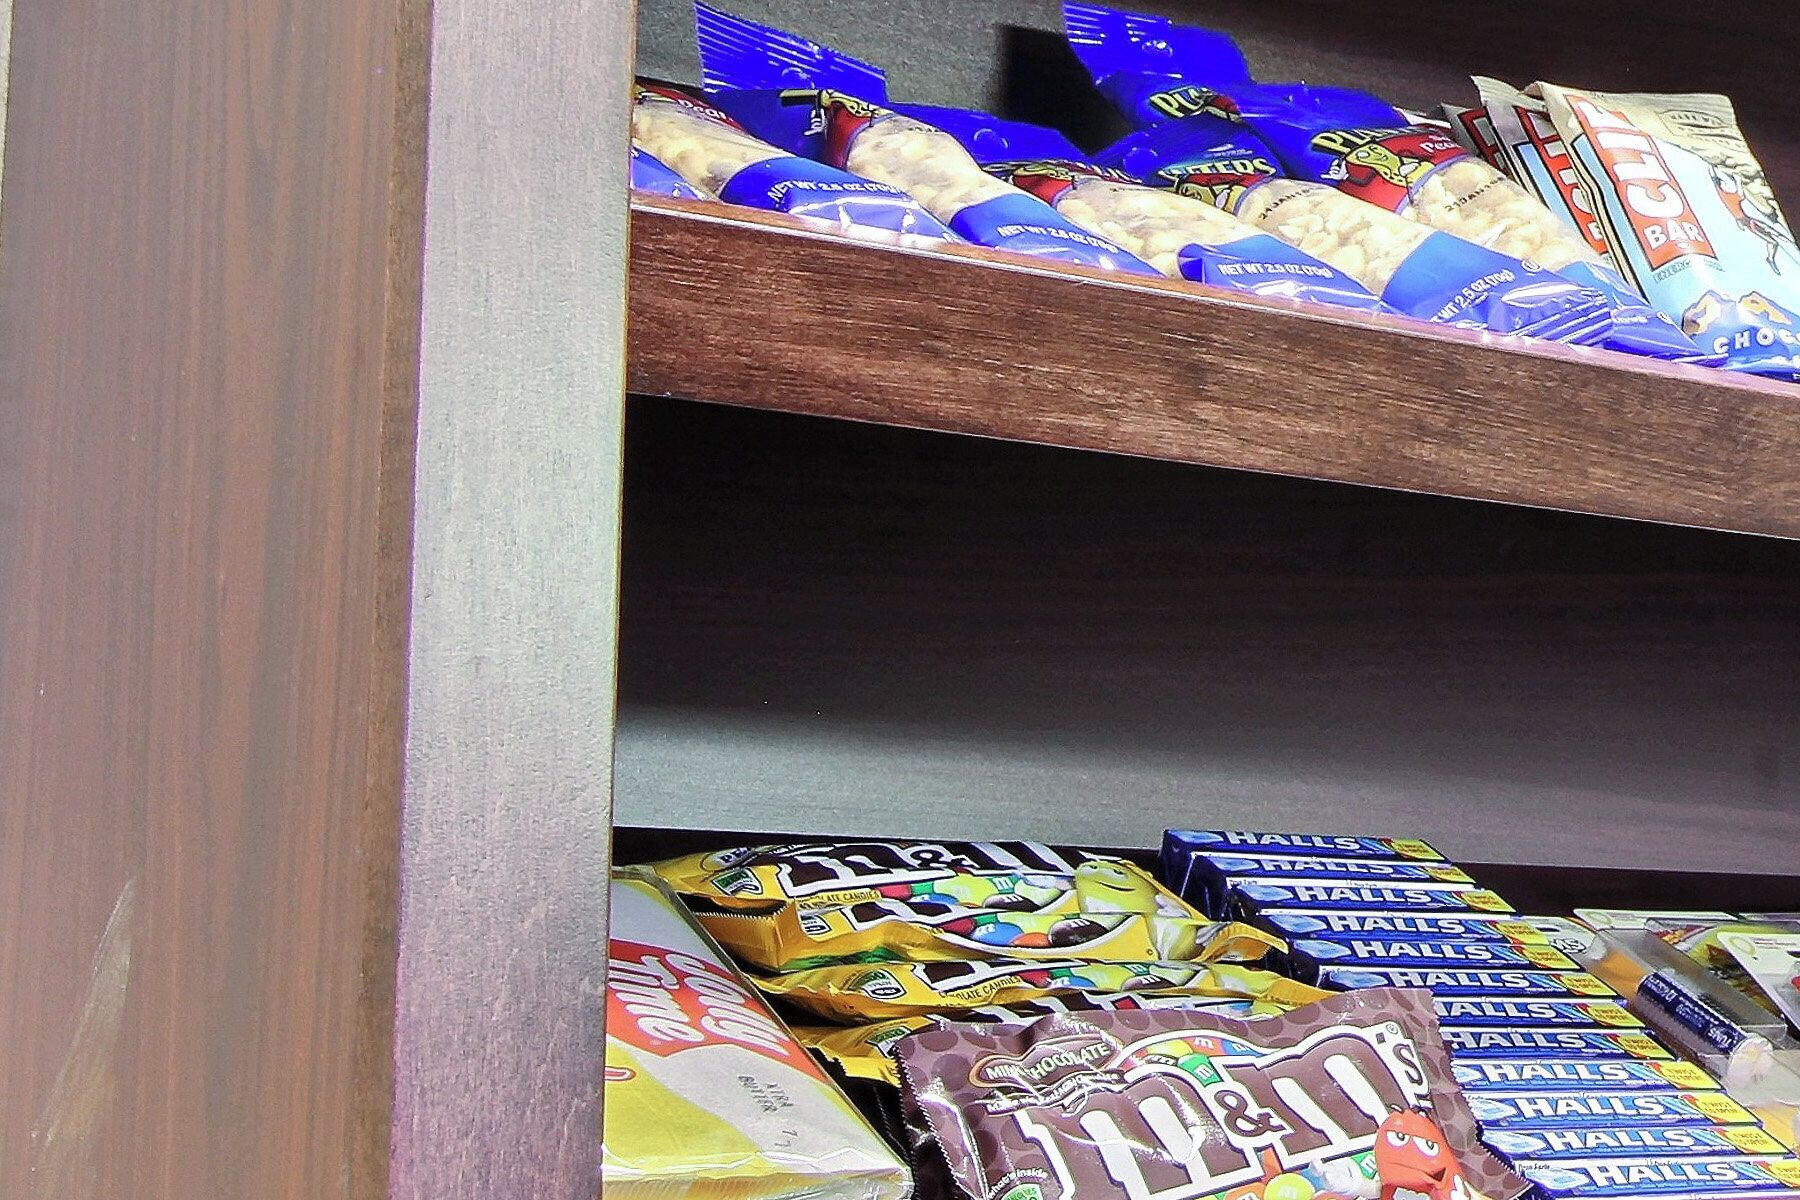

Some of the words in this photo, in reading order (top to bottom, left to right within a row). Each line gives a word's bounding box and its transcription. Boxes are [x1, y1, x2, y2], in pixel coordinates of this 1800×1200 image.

[997, 225, 1024, 238] NET
[1025, 225, 1048, 236] WT
[1643, 220, 1705, 252] BAR
[1217, 264, 1243, 275] NET
[1244, 263, 1264, 274] WT
[1225, 831, 1361, 850] HALLS
[842, 890, 881, 902] CANDIES
[1293, 886, 1431, 903] HALLS
[1326, 915, 1466, 934] HALLS
[1352, 941, 1492, 960] HALLS
[1388, 971, 1530, 988] HALLS
[608, 954, 705, 1041] Time
[665, 953, 790, 1057] Jolly
[1451, 1031, 1587, 1049] HALLS
[1027, 1042, 1111, 1081] HOCOLATE
[1478, 1062, 1631, 1082] HALLS
[1513, 1096, 1666, 1118] HALLS
[1543, 1129, 1696, 1151] HALLS
[1583, 1161, 1740, 1187] HALLS
